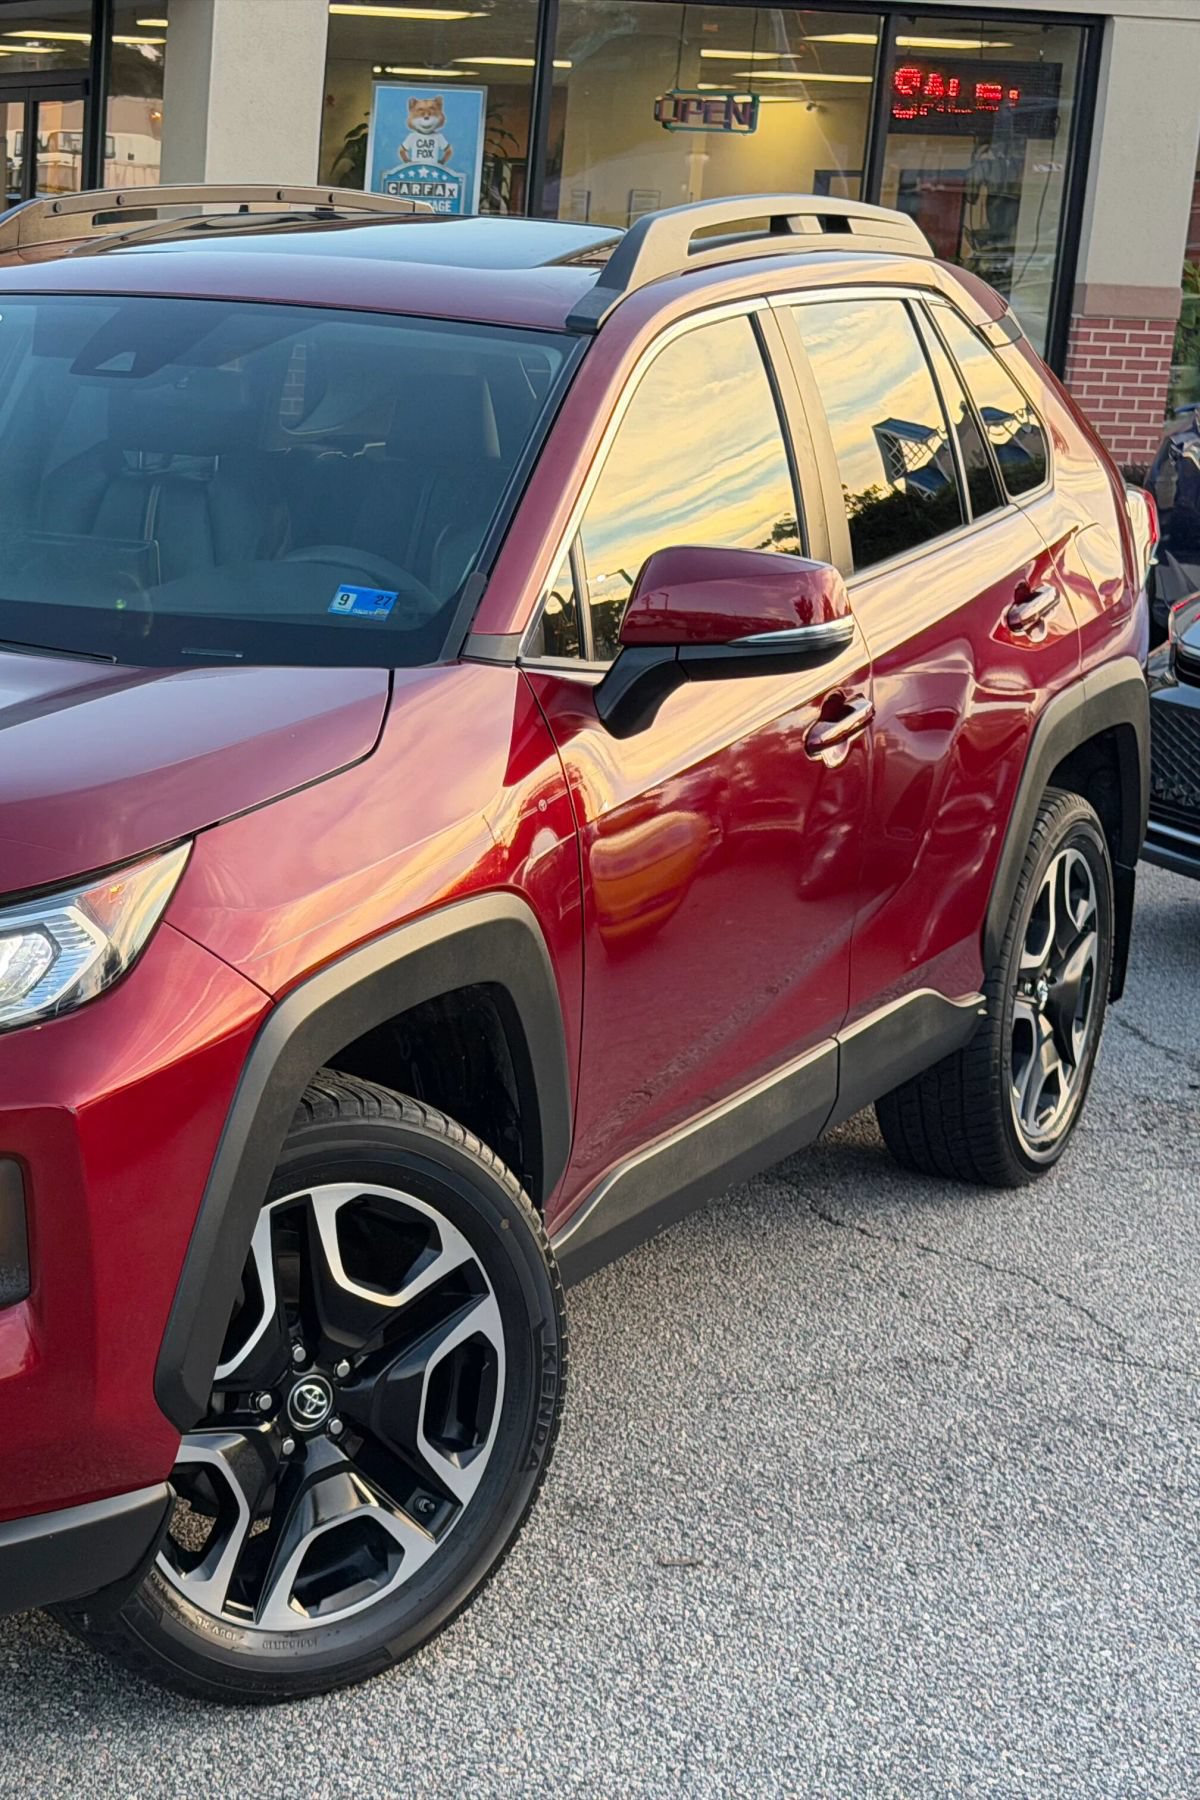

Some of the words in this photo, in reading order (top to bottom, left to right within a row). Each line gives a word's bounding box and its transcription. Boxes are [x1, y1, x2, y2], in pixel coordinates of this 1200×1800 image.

[655, 97, 755, 130] OPEN
[416, 139, 435, 149] CAR
[416, 149, 434, 159] FOX
[388, 183, 457, 198] CARFAX
[338, 593, 351, 606] 9
[375, 594, 394, 606] 27
[525, 1343, 558, 1472] KENDA
